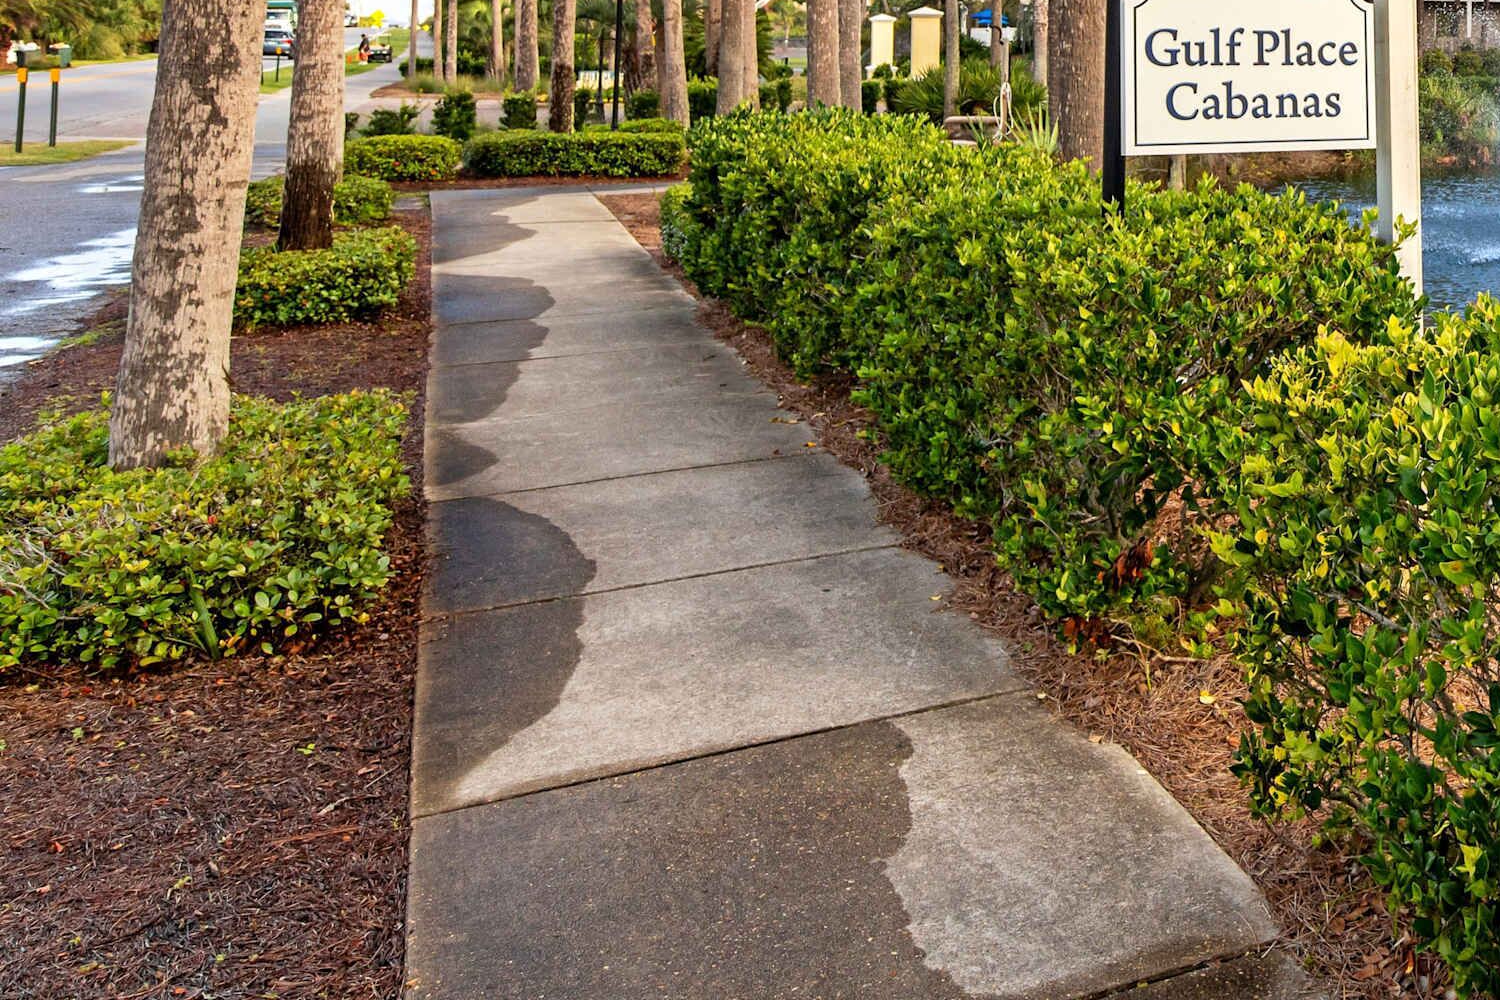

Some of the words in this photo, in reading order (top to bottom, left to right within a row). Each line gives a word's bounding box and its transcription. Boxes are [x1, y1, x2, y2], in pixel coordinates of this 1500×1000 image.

[1144, 27, 1245, 68] Gulf
[1252, 28, 1359, 67] Place
[1165, 80, 1343, 122] Cabanas
